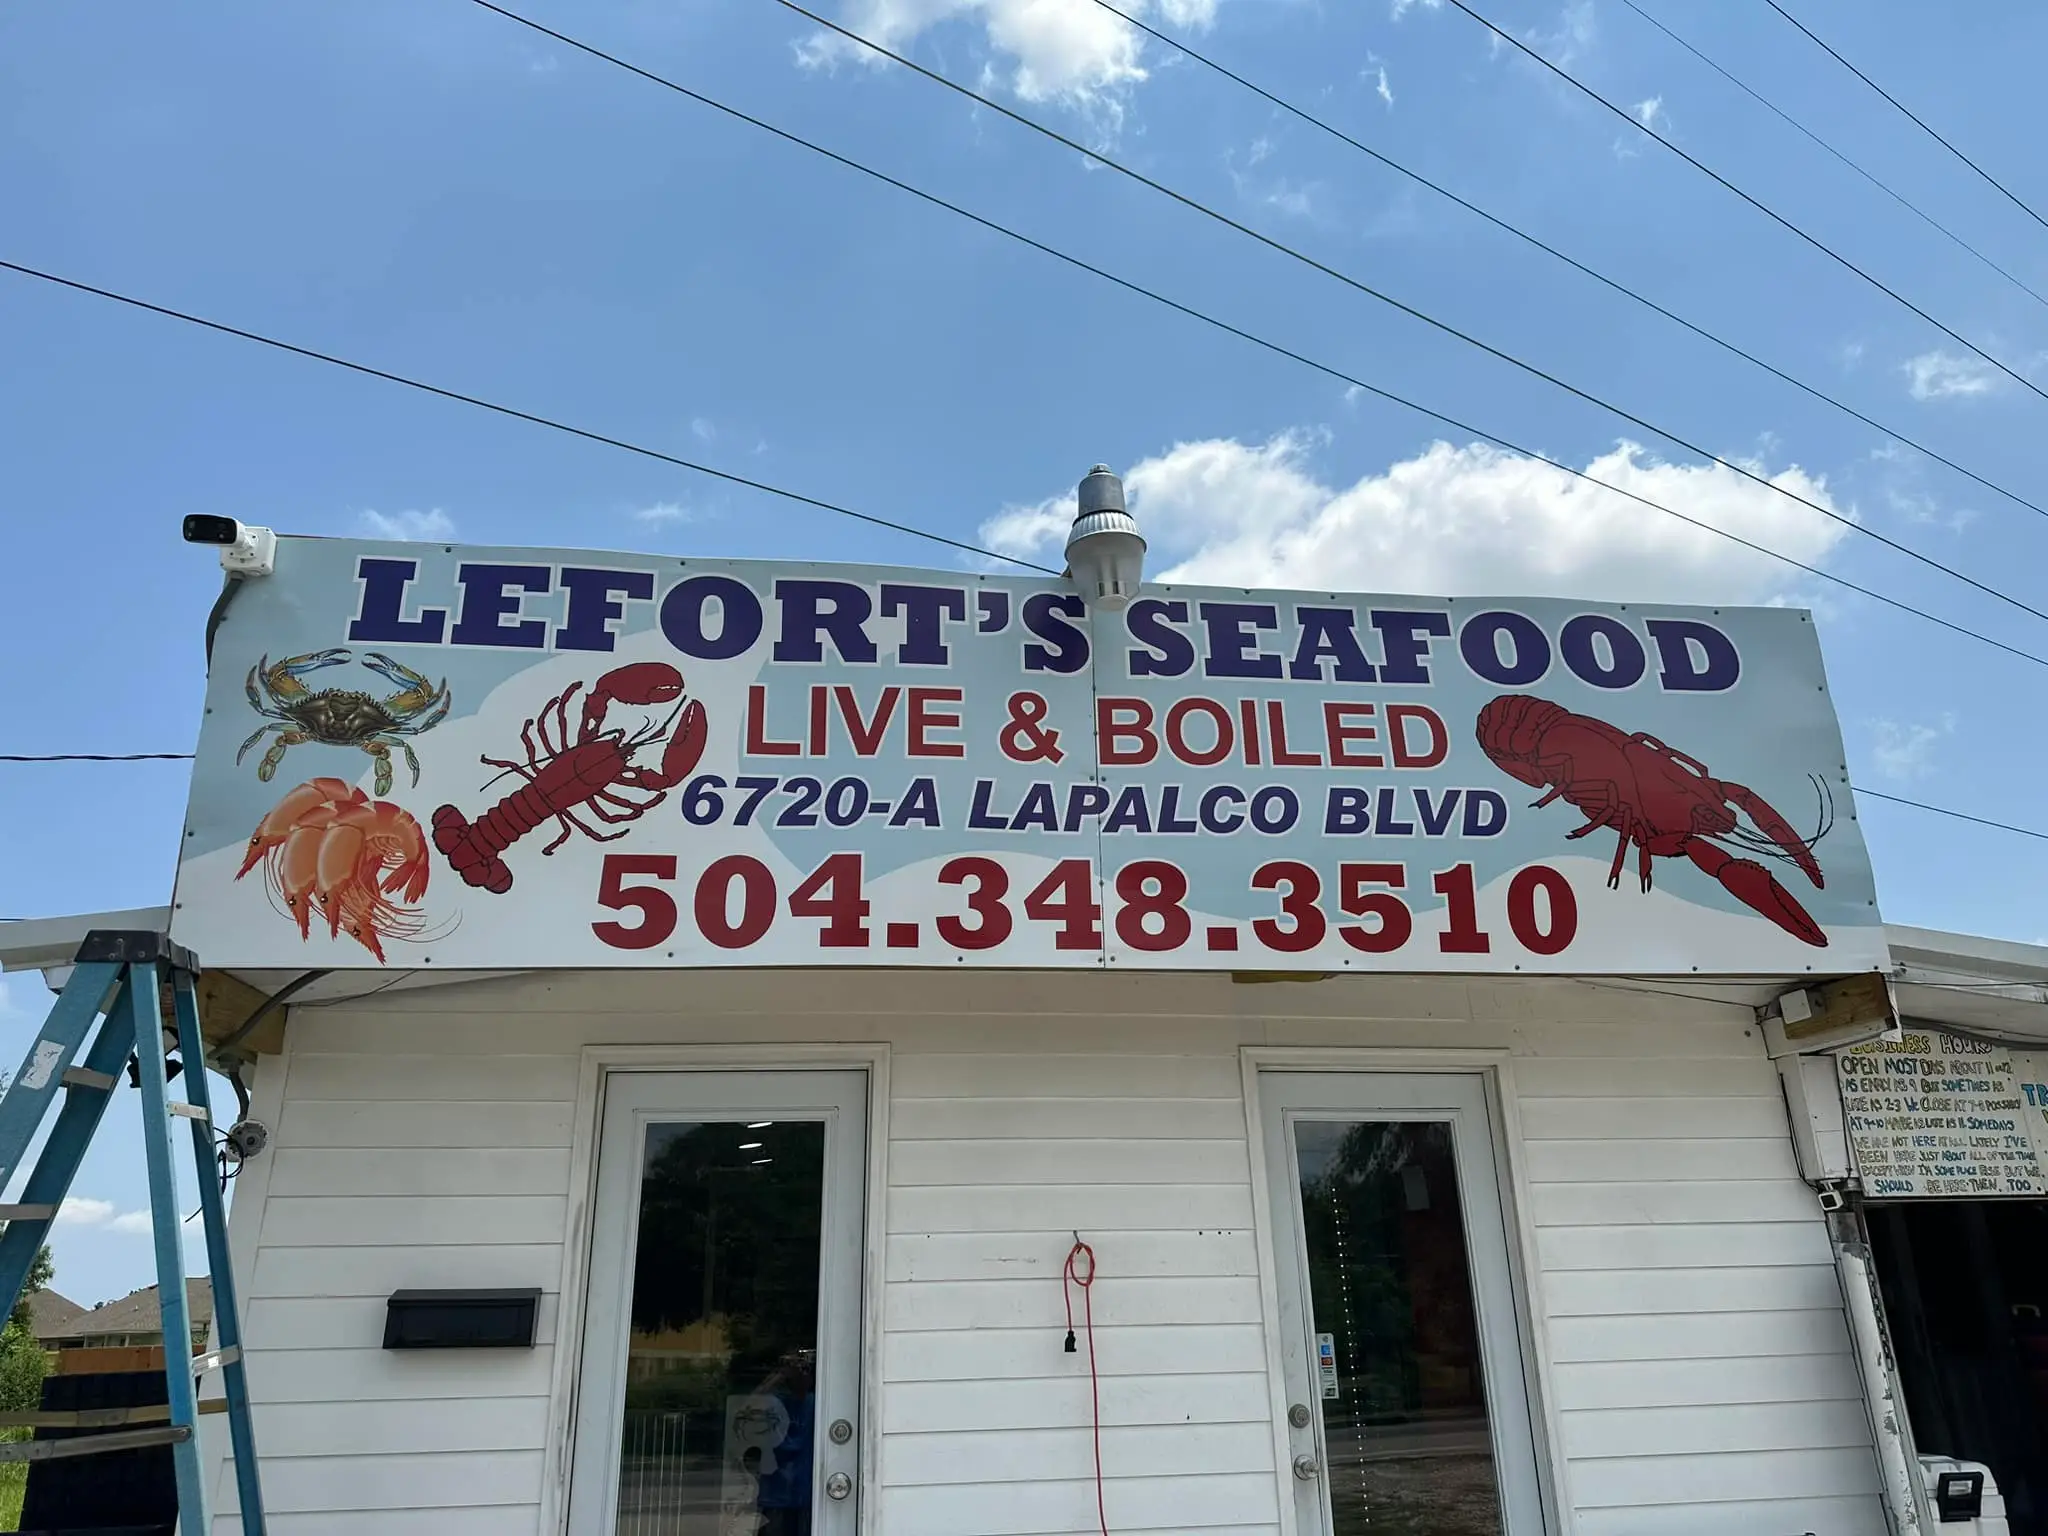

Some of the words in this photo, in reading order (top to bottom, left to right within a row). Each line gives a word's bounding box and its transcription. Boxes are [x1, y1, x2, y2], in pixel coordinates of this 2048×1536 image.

[347, 558, 1090, 675] LEFORT'S
[1127, 600, 1740, 692] SEAFOOD
[747, 686, 964, 758] LIVE
[1000, 691, 1065, 764] &
[1097, 698, 1448, 769] BOILED
[681, 775, 941, 828] 6720-A
[968, 781, 1299, 835] LAPALCO
[1325, 788, 1508, 837] BLVD
[592, 854, 1578, 956] 504.348.3510
[1841, 1056, 1879, 1075] OPEN
[1884, 1057, 1917, 1074] MOST
[1850, 1116, 1863, 1130] AT
[1912, 1136, 1936, 1147] HERE
[1969, 1136, 1999, 1147] LATELY
[1919, 1151, 1939, 1161] JUST
[1941, 1150, 1966, 1161] ABOUT
[1874, 1180, 1913, 1193] SHOULD
[2007, 1179, 2031, 1191] TOO
